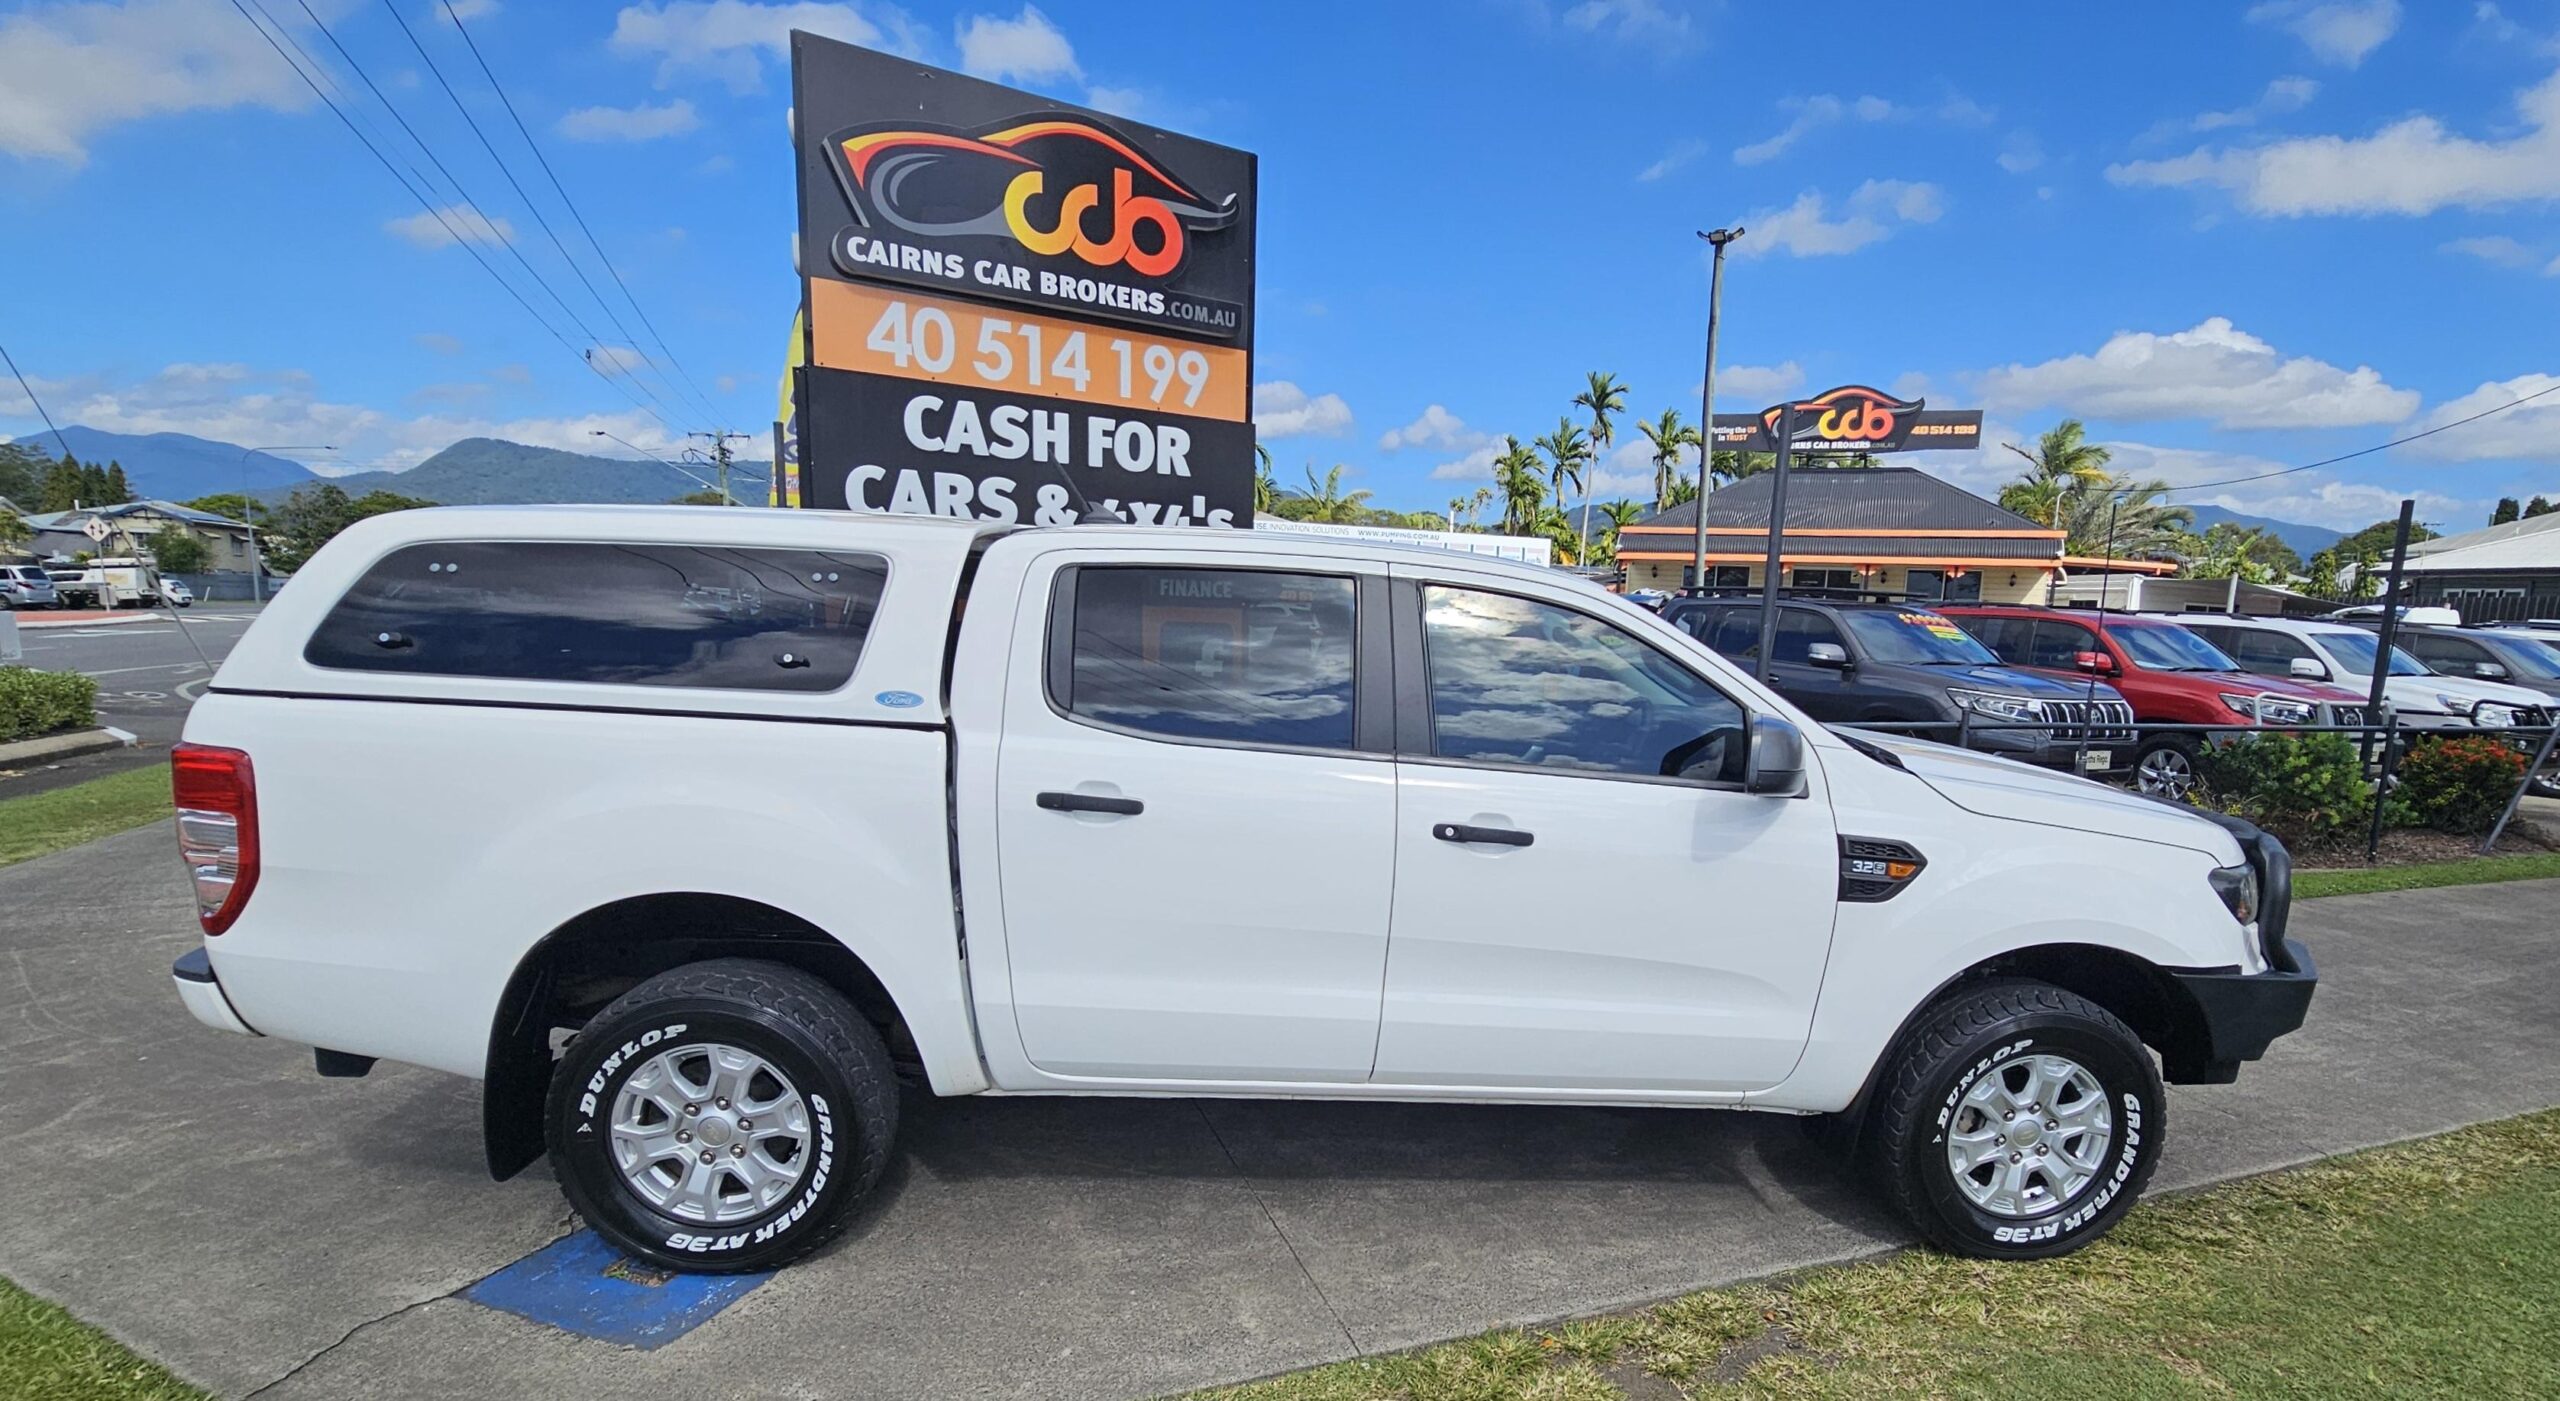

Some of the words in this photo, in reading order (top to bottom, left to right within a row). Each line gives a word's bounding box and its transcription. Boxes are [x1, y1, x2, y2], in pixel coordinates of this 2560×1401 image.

[847, 236, 965, 279] CAIRNS
[974, 260, 1031, 292] CAR
[867, 301, 956, 374] 40
[973, 317, 1091, 393] 514
[1110, 339, 1210, 409] 199
[903, 394, 1071, 465] CASH
[1088, 415, 1192, 478] FOR
[1813, 441, 1830, 449] CAR
[1910, 425, 1930, 435] 40
[1930, 425, 1953, 435] 514
[845, 464, 1019, 525] CARS
[1034, 484, 1079, 527] &
[1269, 523, 1311, 533] INNOVATION
[1312, 525, 1350, 535] SOLUTIONS
[1159, 578, 1233, 599] FINANCE
[578, 1024, 688, 1118] DUNLOP
[1937, 1039, 2034, 1129] DUNLOP
[754, 1093, 835, 1244] GRANDTREK
[2065, 1092, 2141, 1232] GRANDTREK
